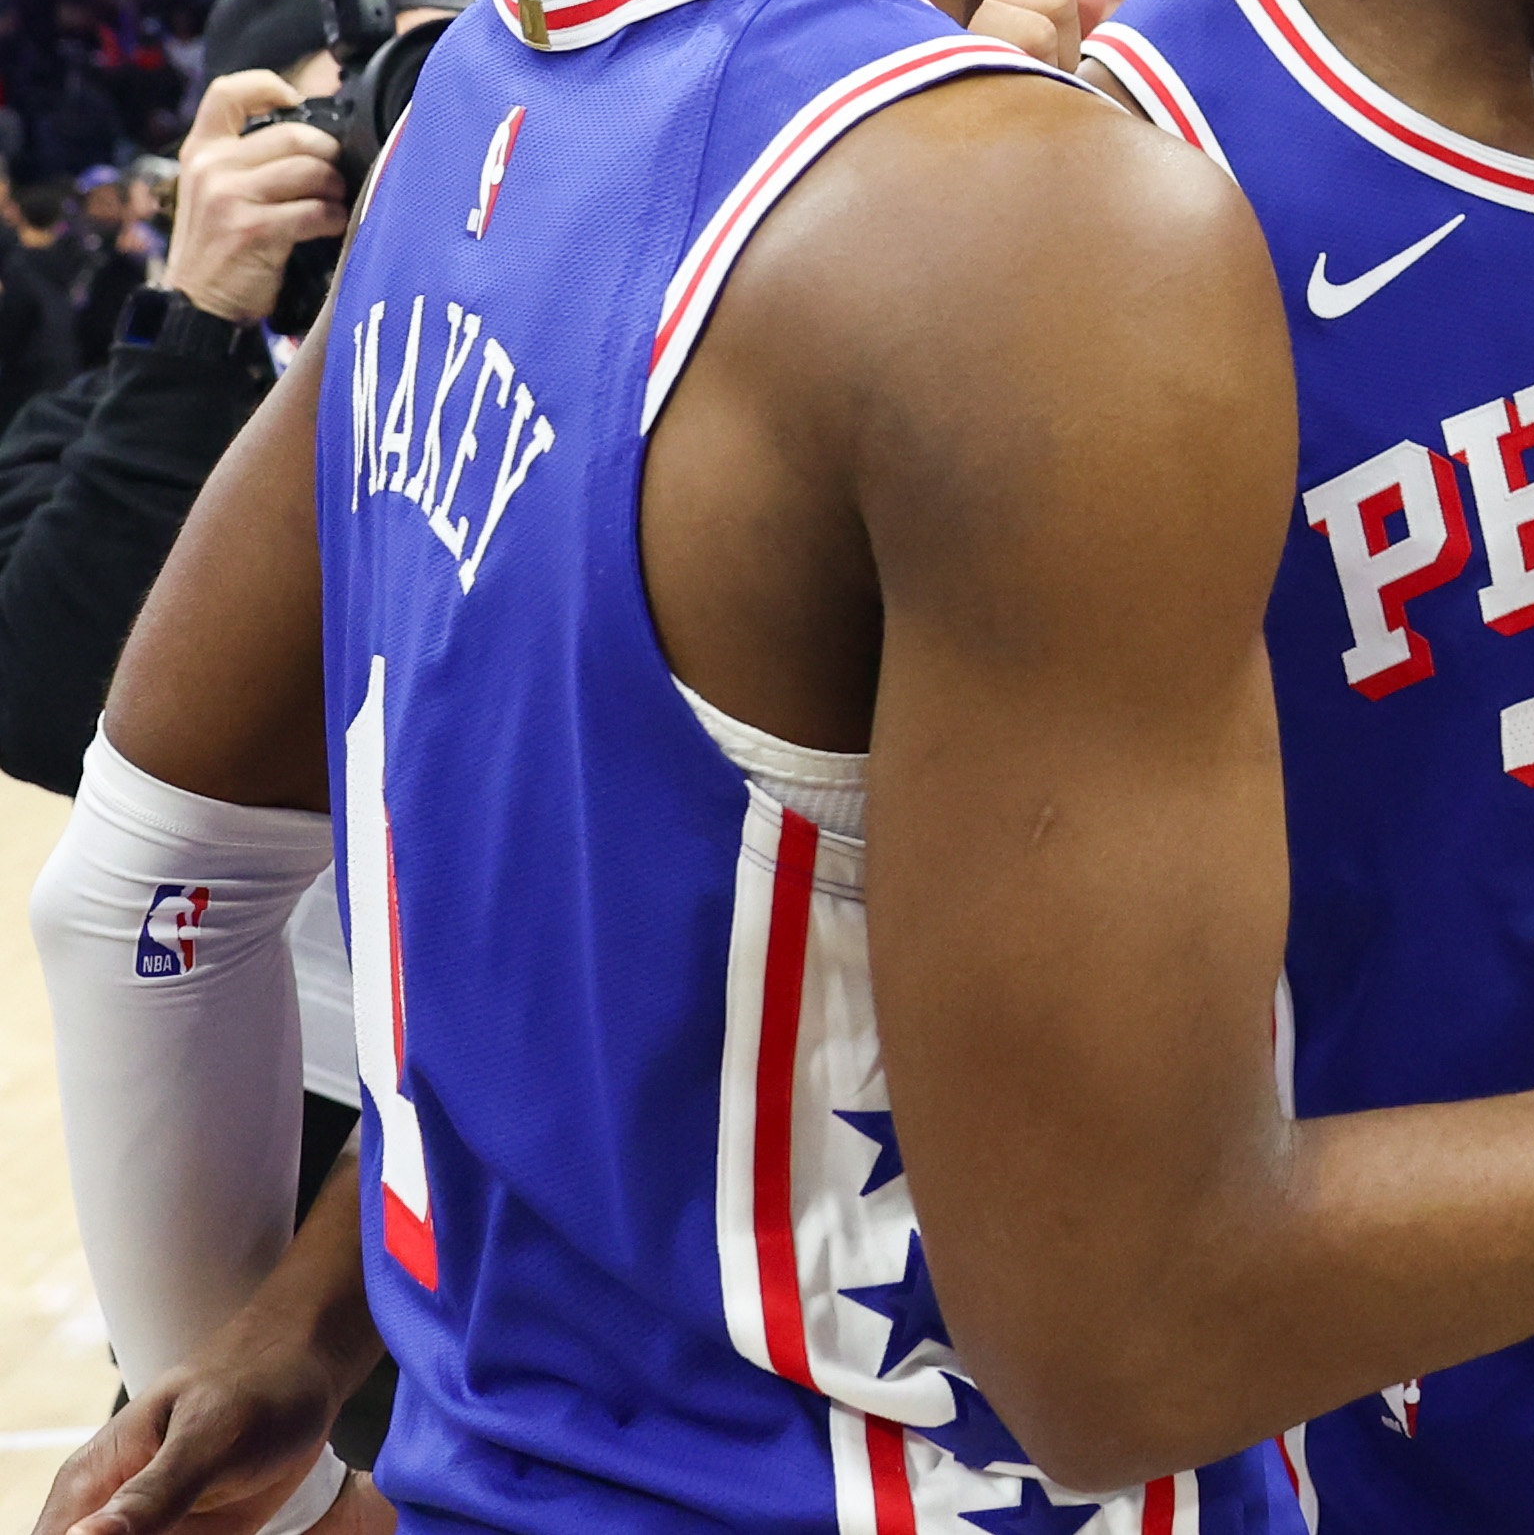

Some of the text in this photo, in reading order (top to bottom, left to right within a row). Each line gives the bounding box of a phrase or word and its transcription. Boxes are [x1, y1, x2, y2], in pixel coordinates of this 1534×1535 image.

[351, 294, 556, 595] MAXEY
[143, 954, 172, 973] NBA
[345, 654, 438, 1293] 1
